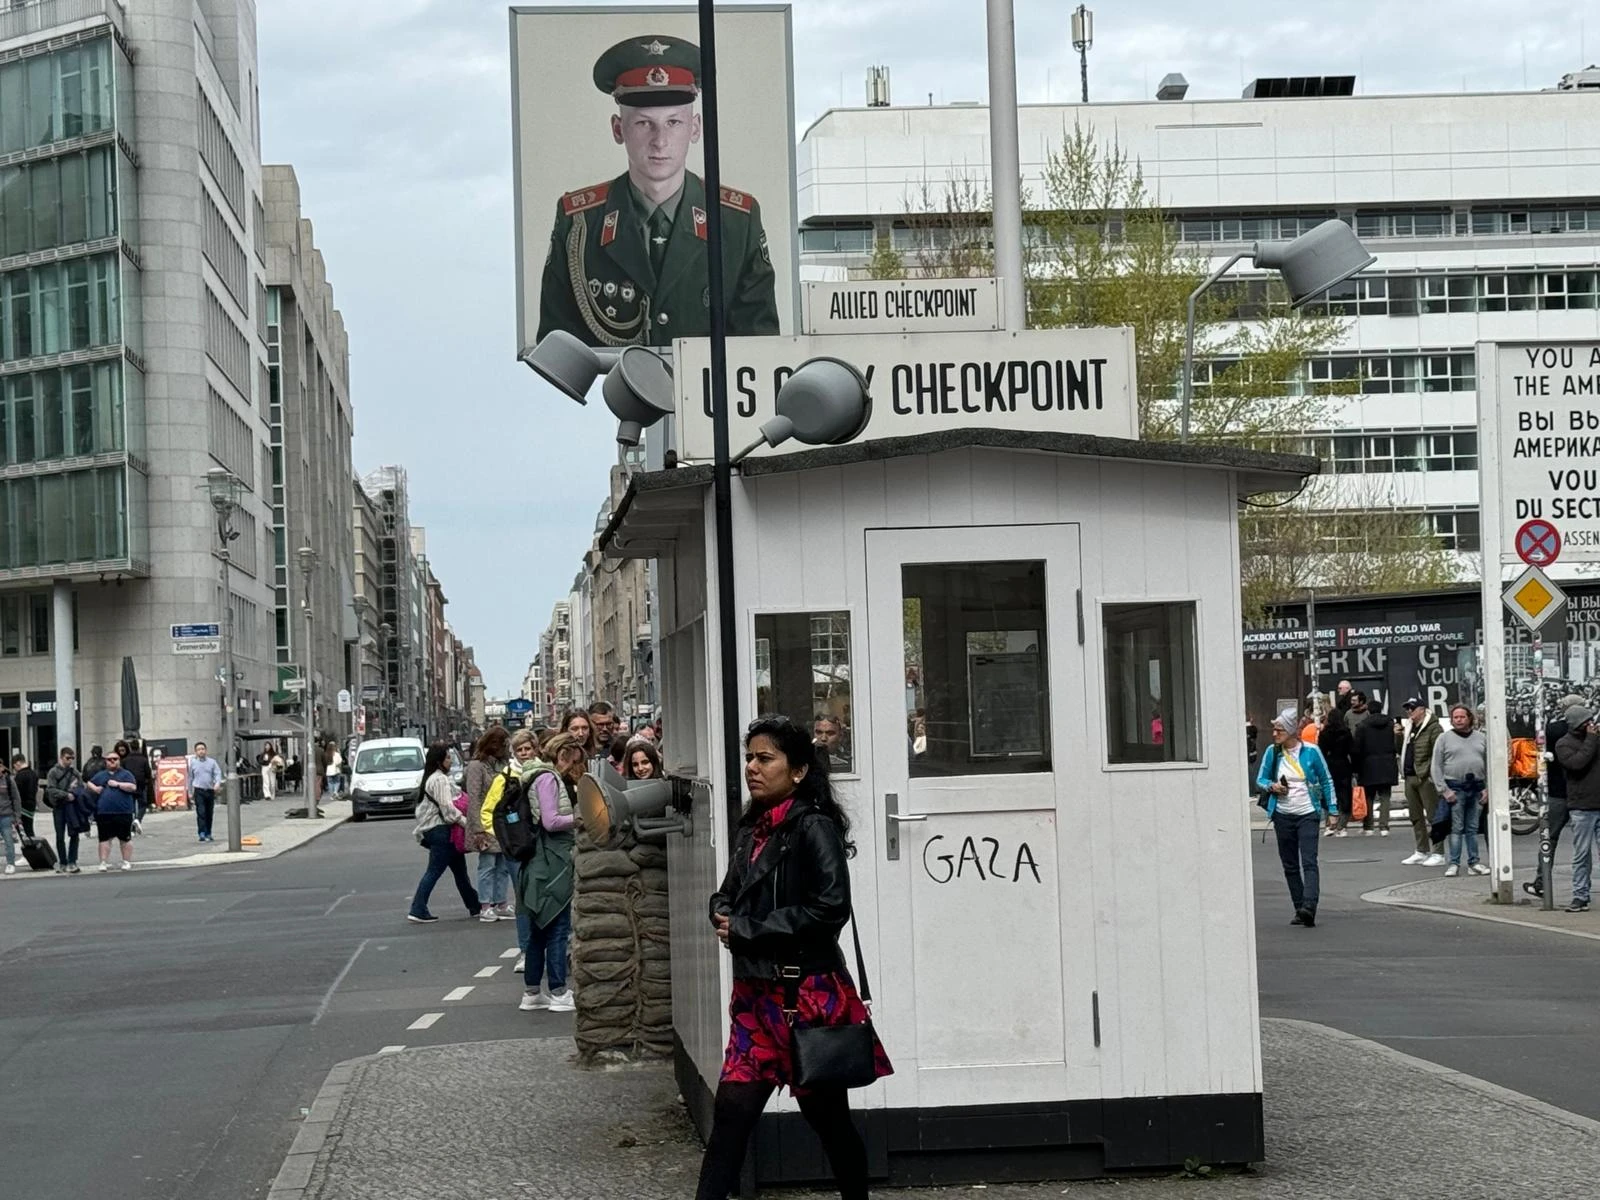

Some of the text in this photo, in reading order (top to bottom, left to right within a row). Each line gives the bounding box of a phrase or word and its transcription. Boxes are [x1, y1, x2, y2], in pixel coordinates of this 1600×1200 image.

[829, 288, 977, 320] ALLIED CHECKPOINT
[1525, 347, 1573, 369] YOU
[891, 358, 1107, 415] CHECKPOINT
[1513, 375, 1550, 396] THE
[1518, 410, 1554, 432] ВЫ
[1513, 436, 1600, 458] АМЕРИКА
[1548, 469, 1597, 491] VOU
[1515, 497, 1600, 520] DU SECT
[1278, 630, 1309, 641] KALTER
[1347, 623, 1441, 637] BLACKBOX COLD WAR
[1393, 633, 1434, 643] CHECKPOINT
[1435, 631, 1465, 641] CHARLIE
